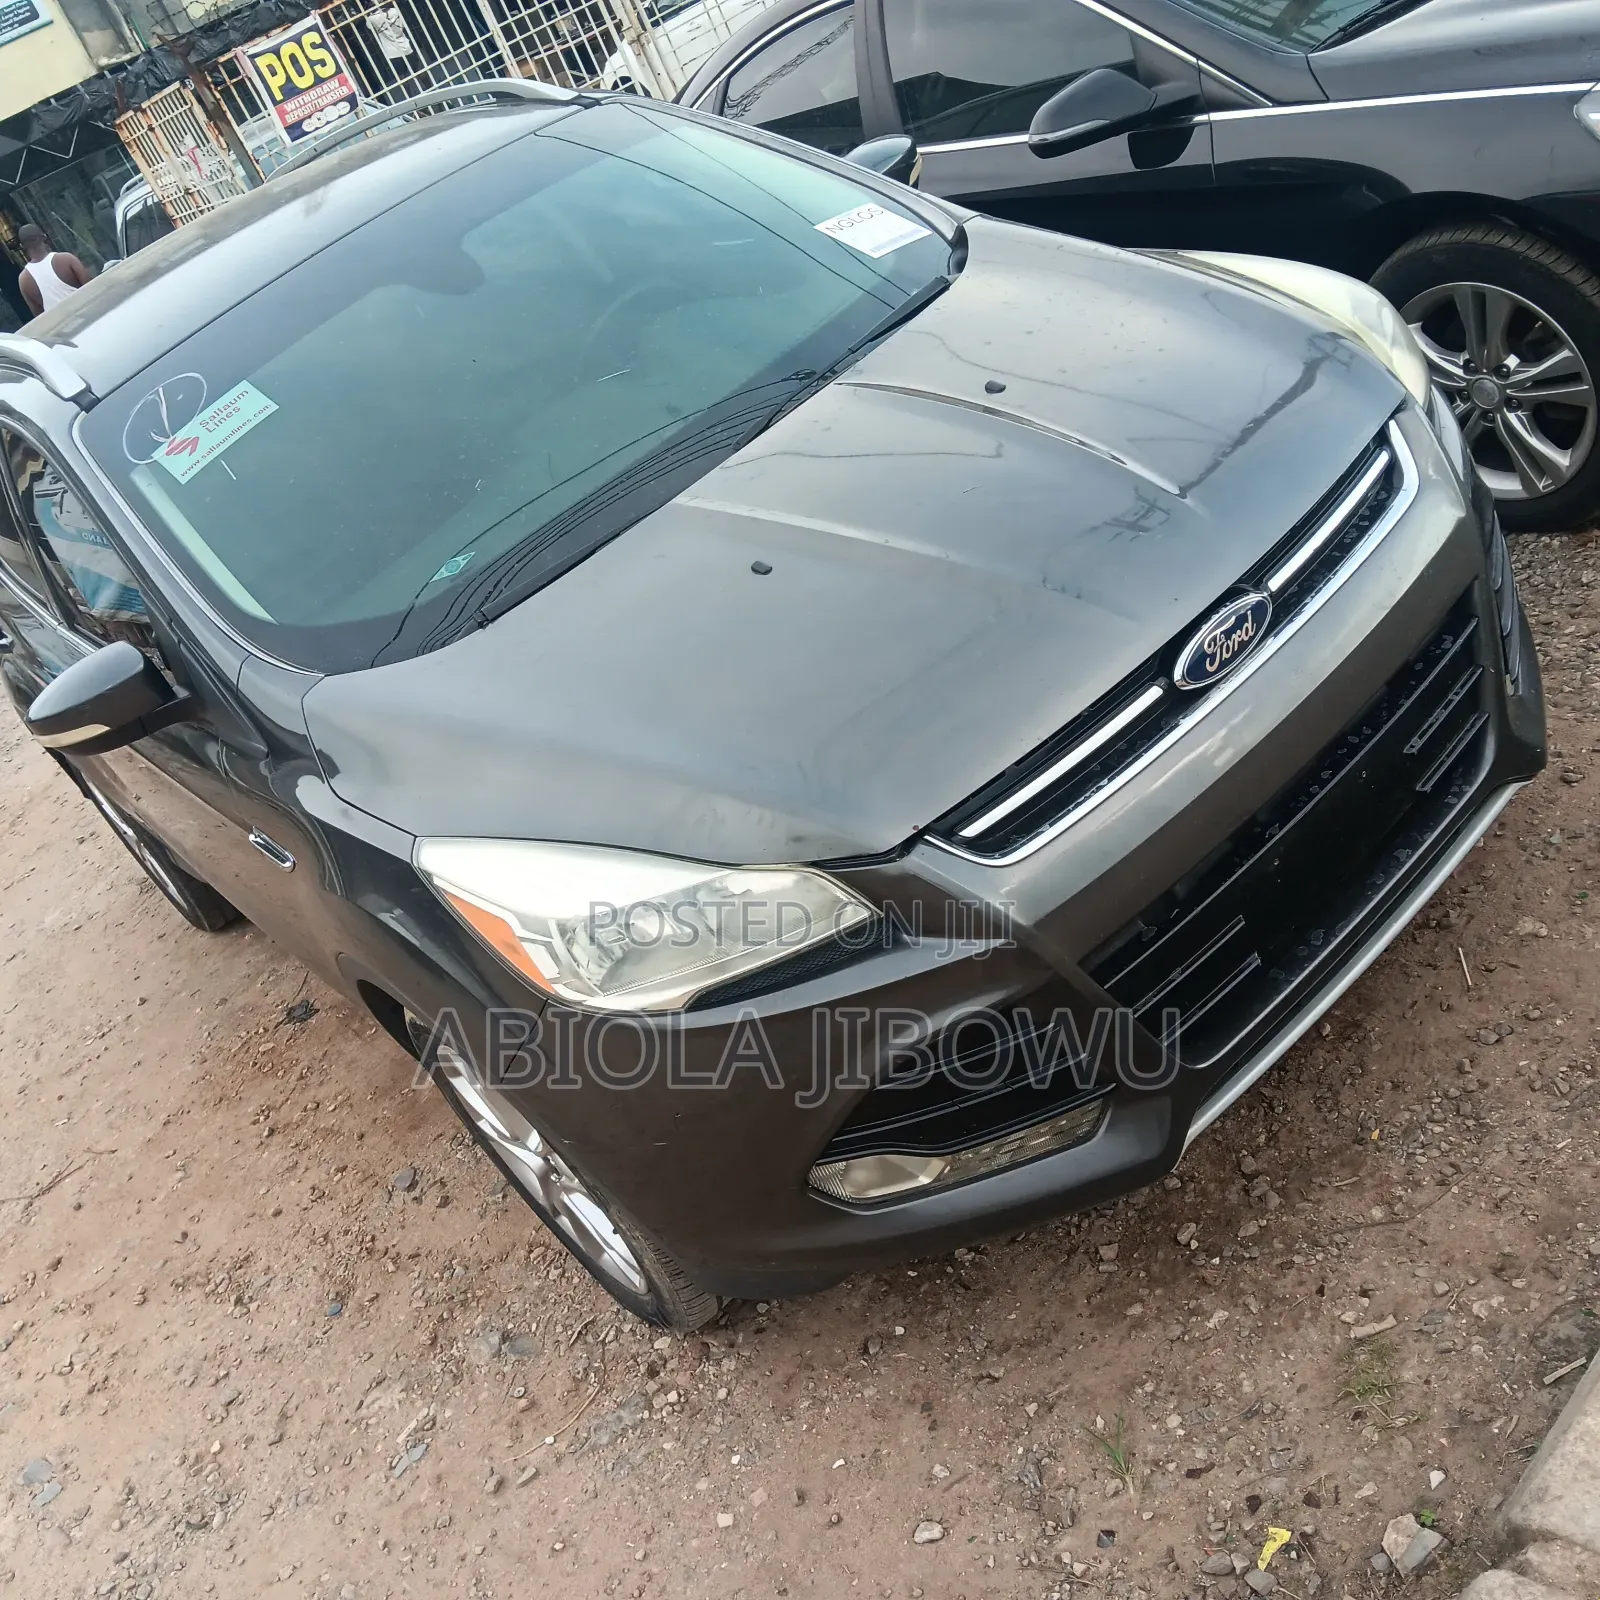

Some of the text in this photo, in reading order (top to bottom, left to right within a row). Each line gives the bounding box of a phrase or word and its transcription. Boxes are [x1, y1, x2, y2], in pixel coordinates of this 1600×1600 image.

[254, 31, 336, 101] POS
[284, 79, 339, 112] WITHDRAW
[285, 86, 349, 123] DEPOSIT/TRANSFER
[825, 207, 884, 233] NGLOS
[200, 389, 249, 428] Sallaum
[205, 406, 241, 433] Lines
[180, 404, 272, 477] www.sallaumlines.com
[1204, 610, 1256, 672] Ford
